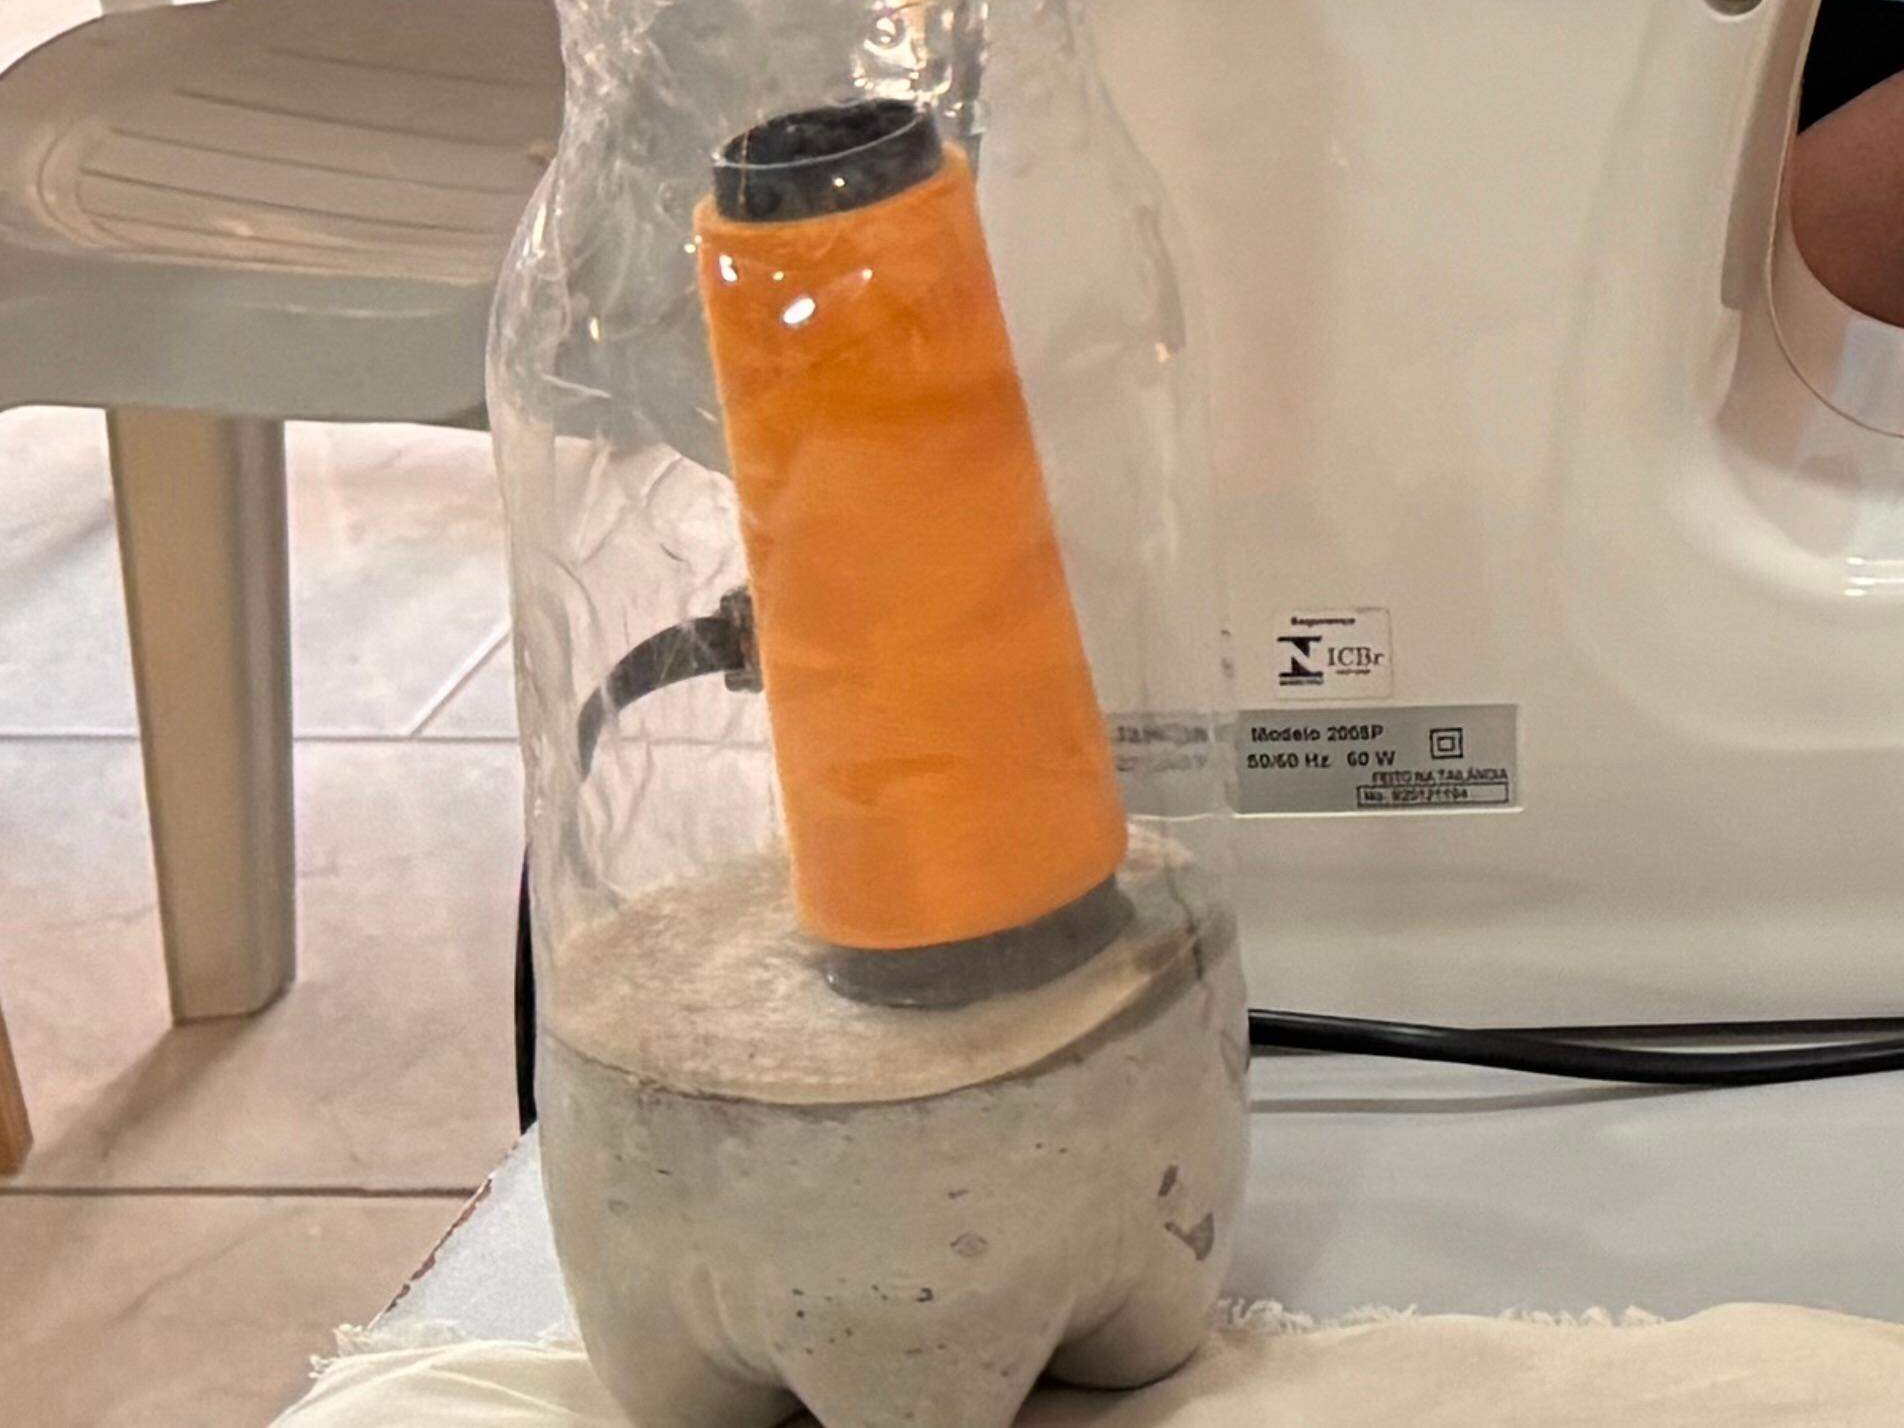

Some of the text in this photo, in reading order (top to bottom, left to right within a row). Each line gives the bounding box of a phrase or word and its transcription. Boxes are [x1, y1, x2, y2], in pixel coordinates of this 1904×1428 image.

[1327, 647, 1384, 666] ICBr
[1251, 727, 1321, 742] Modelo
[1247, 749, 1396, 770] 50/60 Hz 60 W
